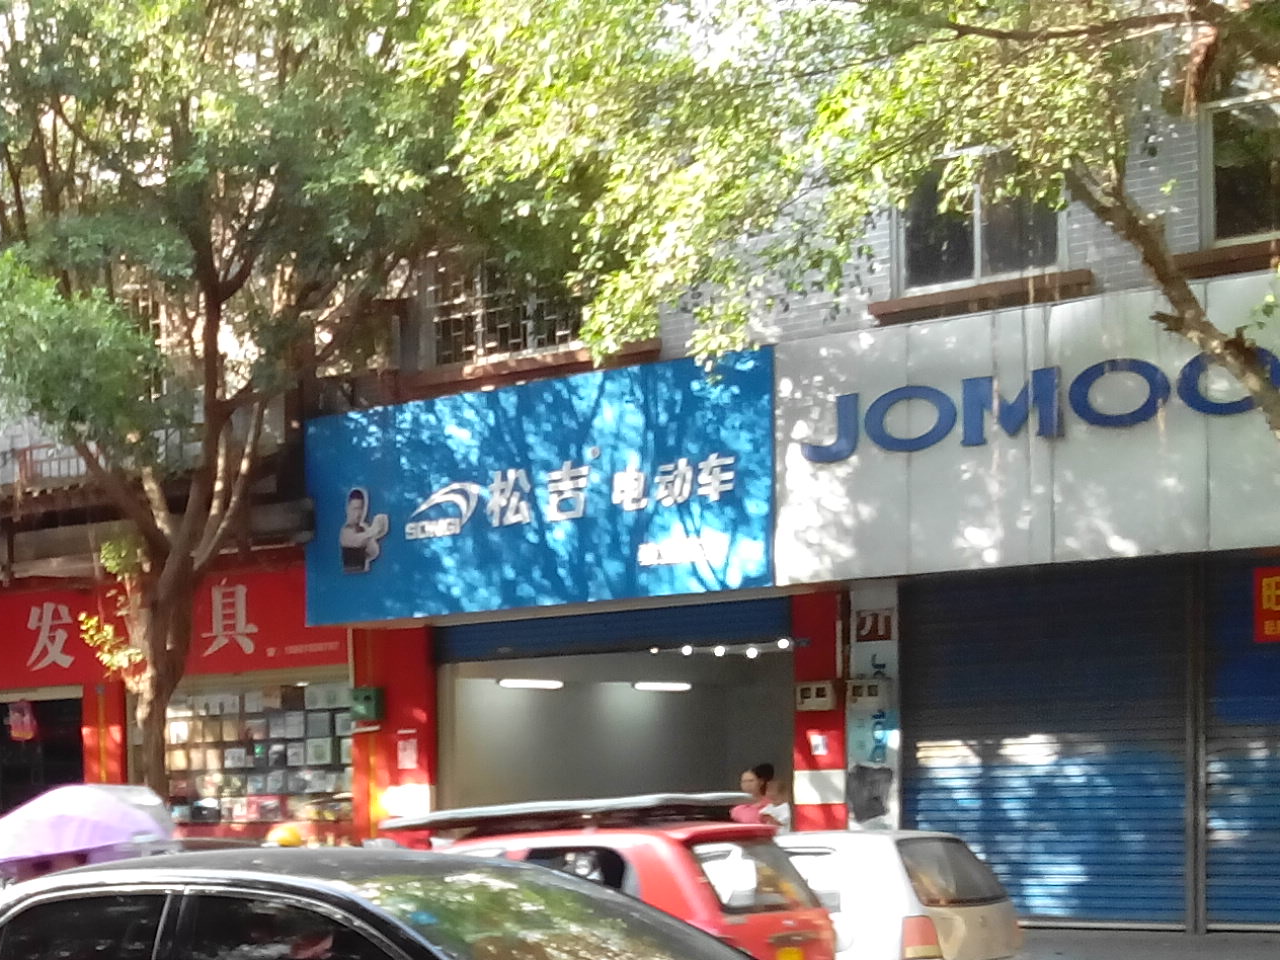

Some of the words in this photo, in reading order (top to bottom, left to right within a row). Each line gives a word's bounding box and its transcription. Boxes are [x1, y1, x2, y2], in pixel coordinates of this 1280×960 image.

[486, 460, 589, 528] 松吉
[611, 452, 736, 512] 电动车
